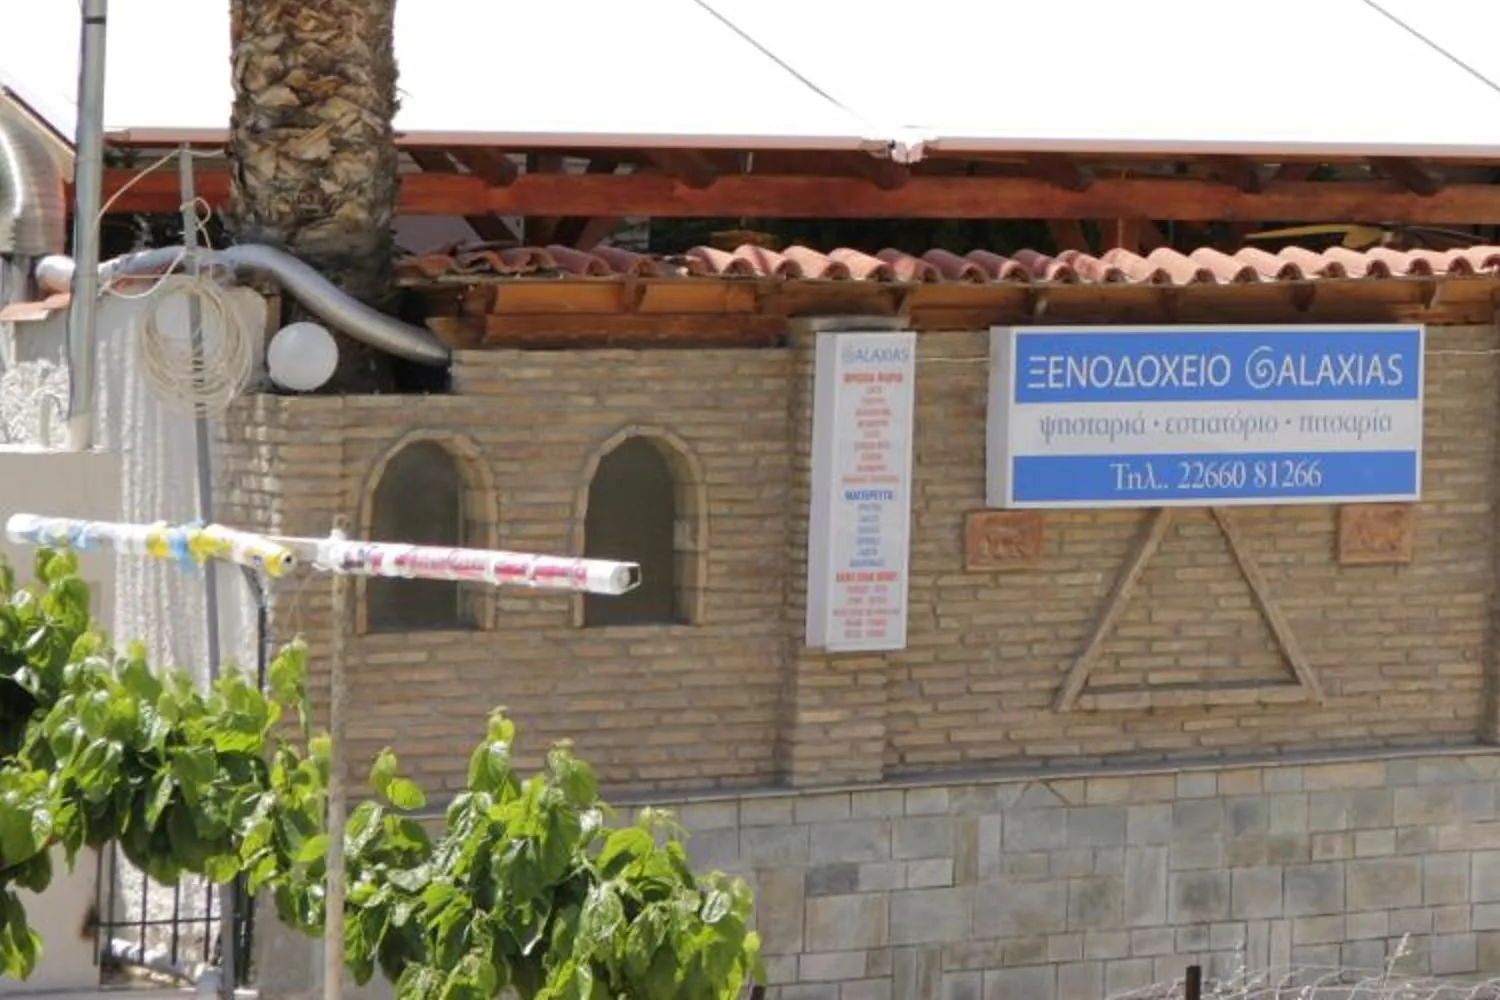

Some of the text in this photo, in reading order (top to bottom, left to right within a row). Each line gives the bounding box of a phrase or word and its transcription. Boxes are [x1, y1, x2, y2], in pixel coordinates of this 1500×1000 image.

[1027, 345, 1403, 389] ΞΕΝΟΔΟΧΕΙΟ GALAXIAS
[1040, 407, 1393, 445] ψησταριά εστιατόριο πιτσαρία
[1177, 459, 1246, 489] 22660
[1254, 457, 1323, 488] 81266
